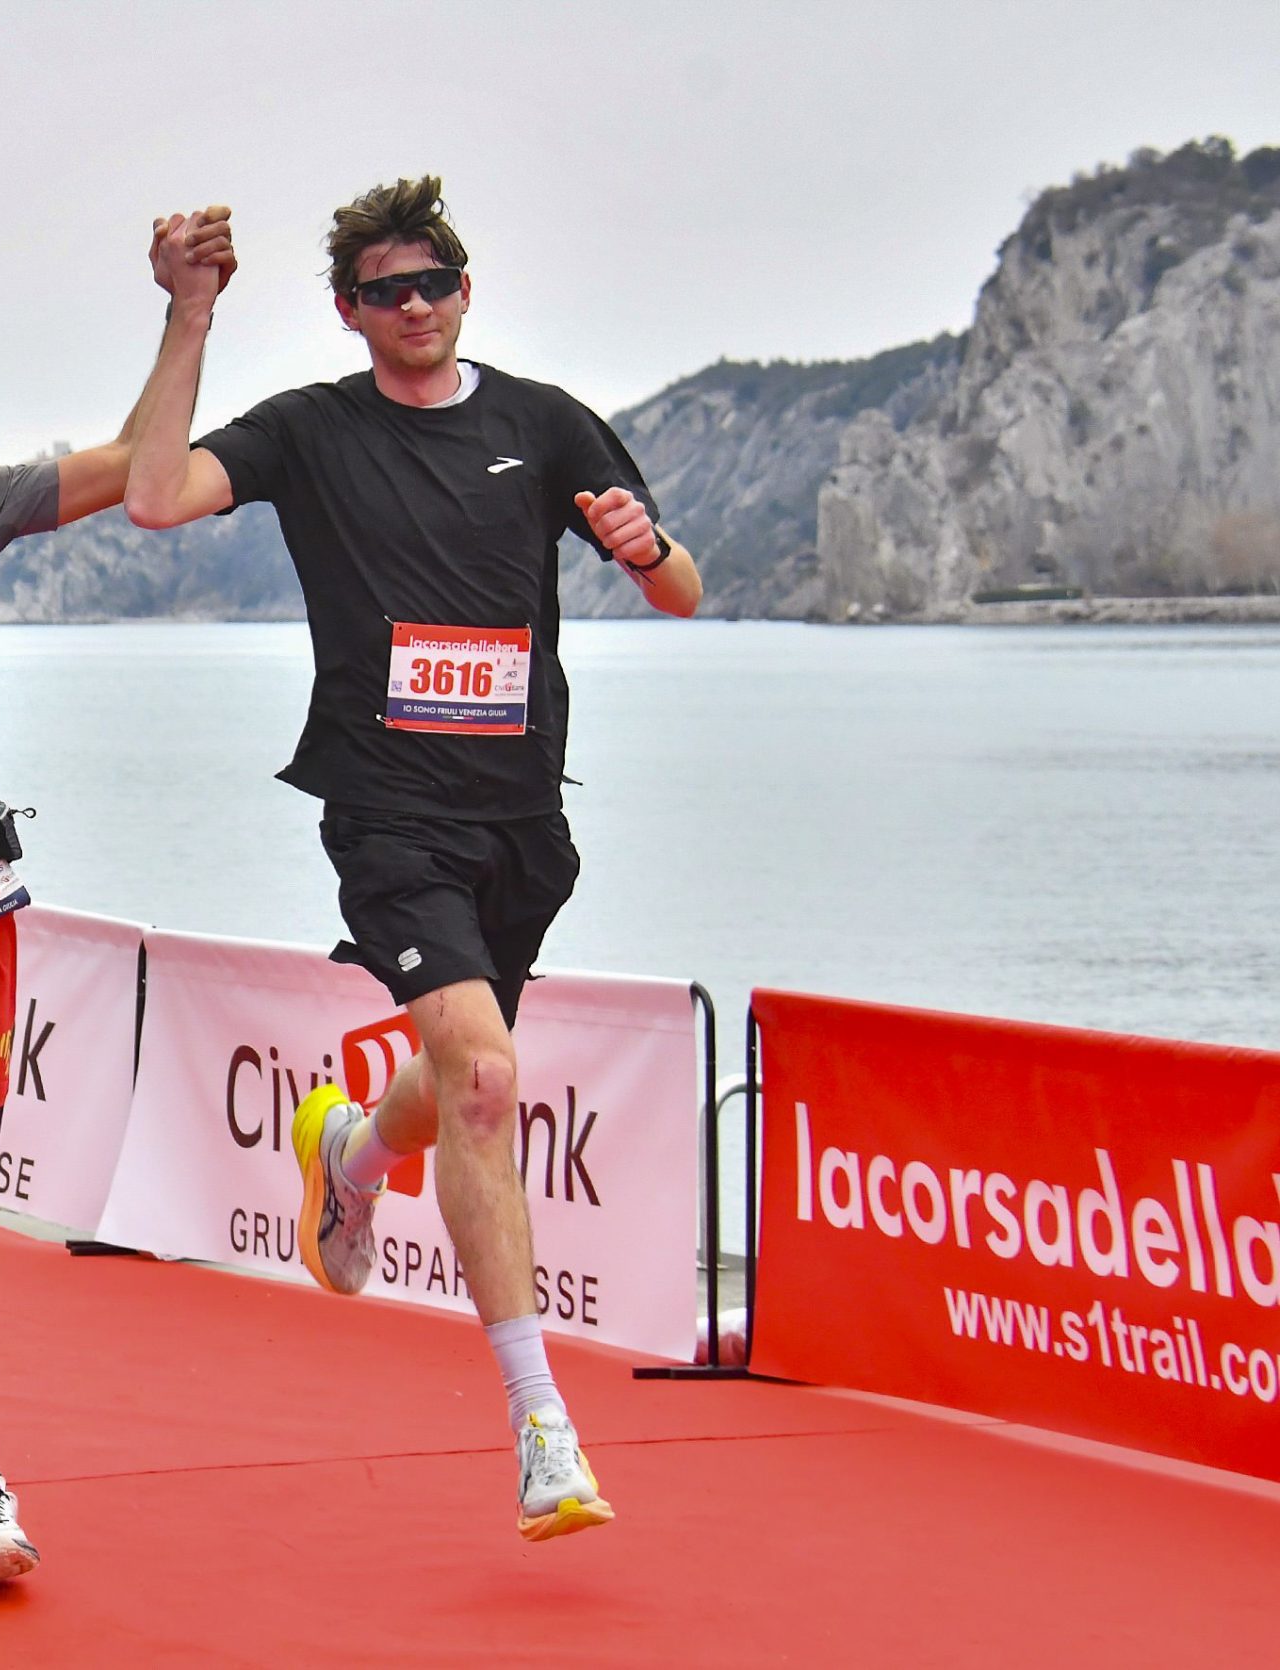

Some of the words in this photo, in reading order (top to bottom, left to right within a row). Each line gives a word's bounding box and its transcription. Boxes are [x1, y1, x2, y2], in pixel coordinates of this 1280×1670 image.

[409, 634, 519, 653] lacorsadellabora
[409, 658, 493, 697] 3616
[403, 705, 412, 713] IO
[413, 705, 437, 715] SONO
[437, 706, 458, 716] FRIULI
[458, 707, 487, 717] VENEZIA
[488, 709, 507, 717] GIULIA
[794, 1101, 1280, 1309] lacorsadella
[944, 1286, 1280, 1403] www.s1trail.co
